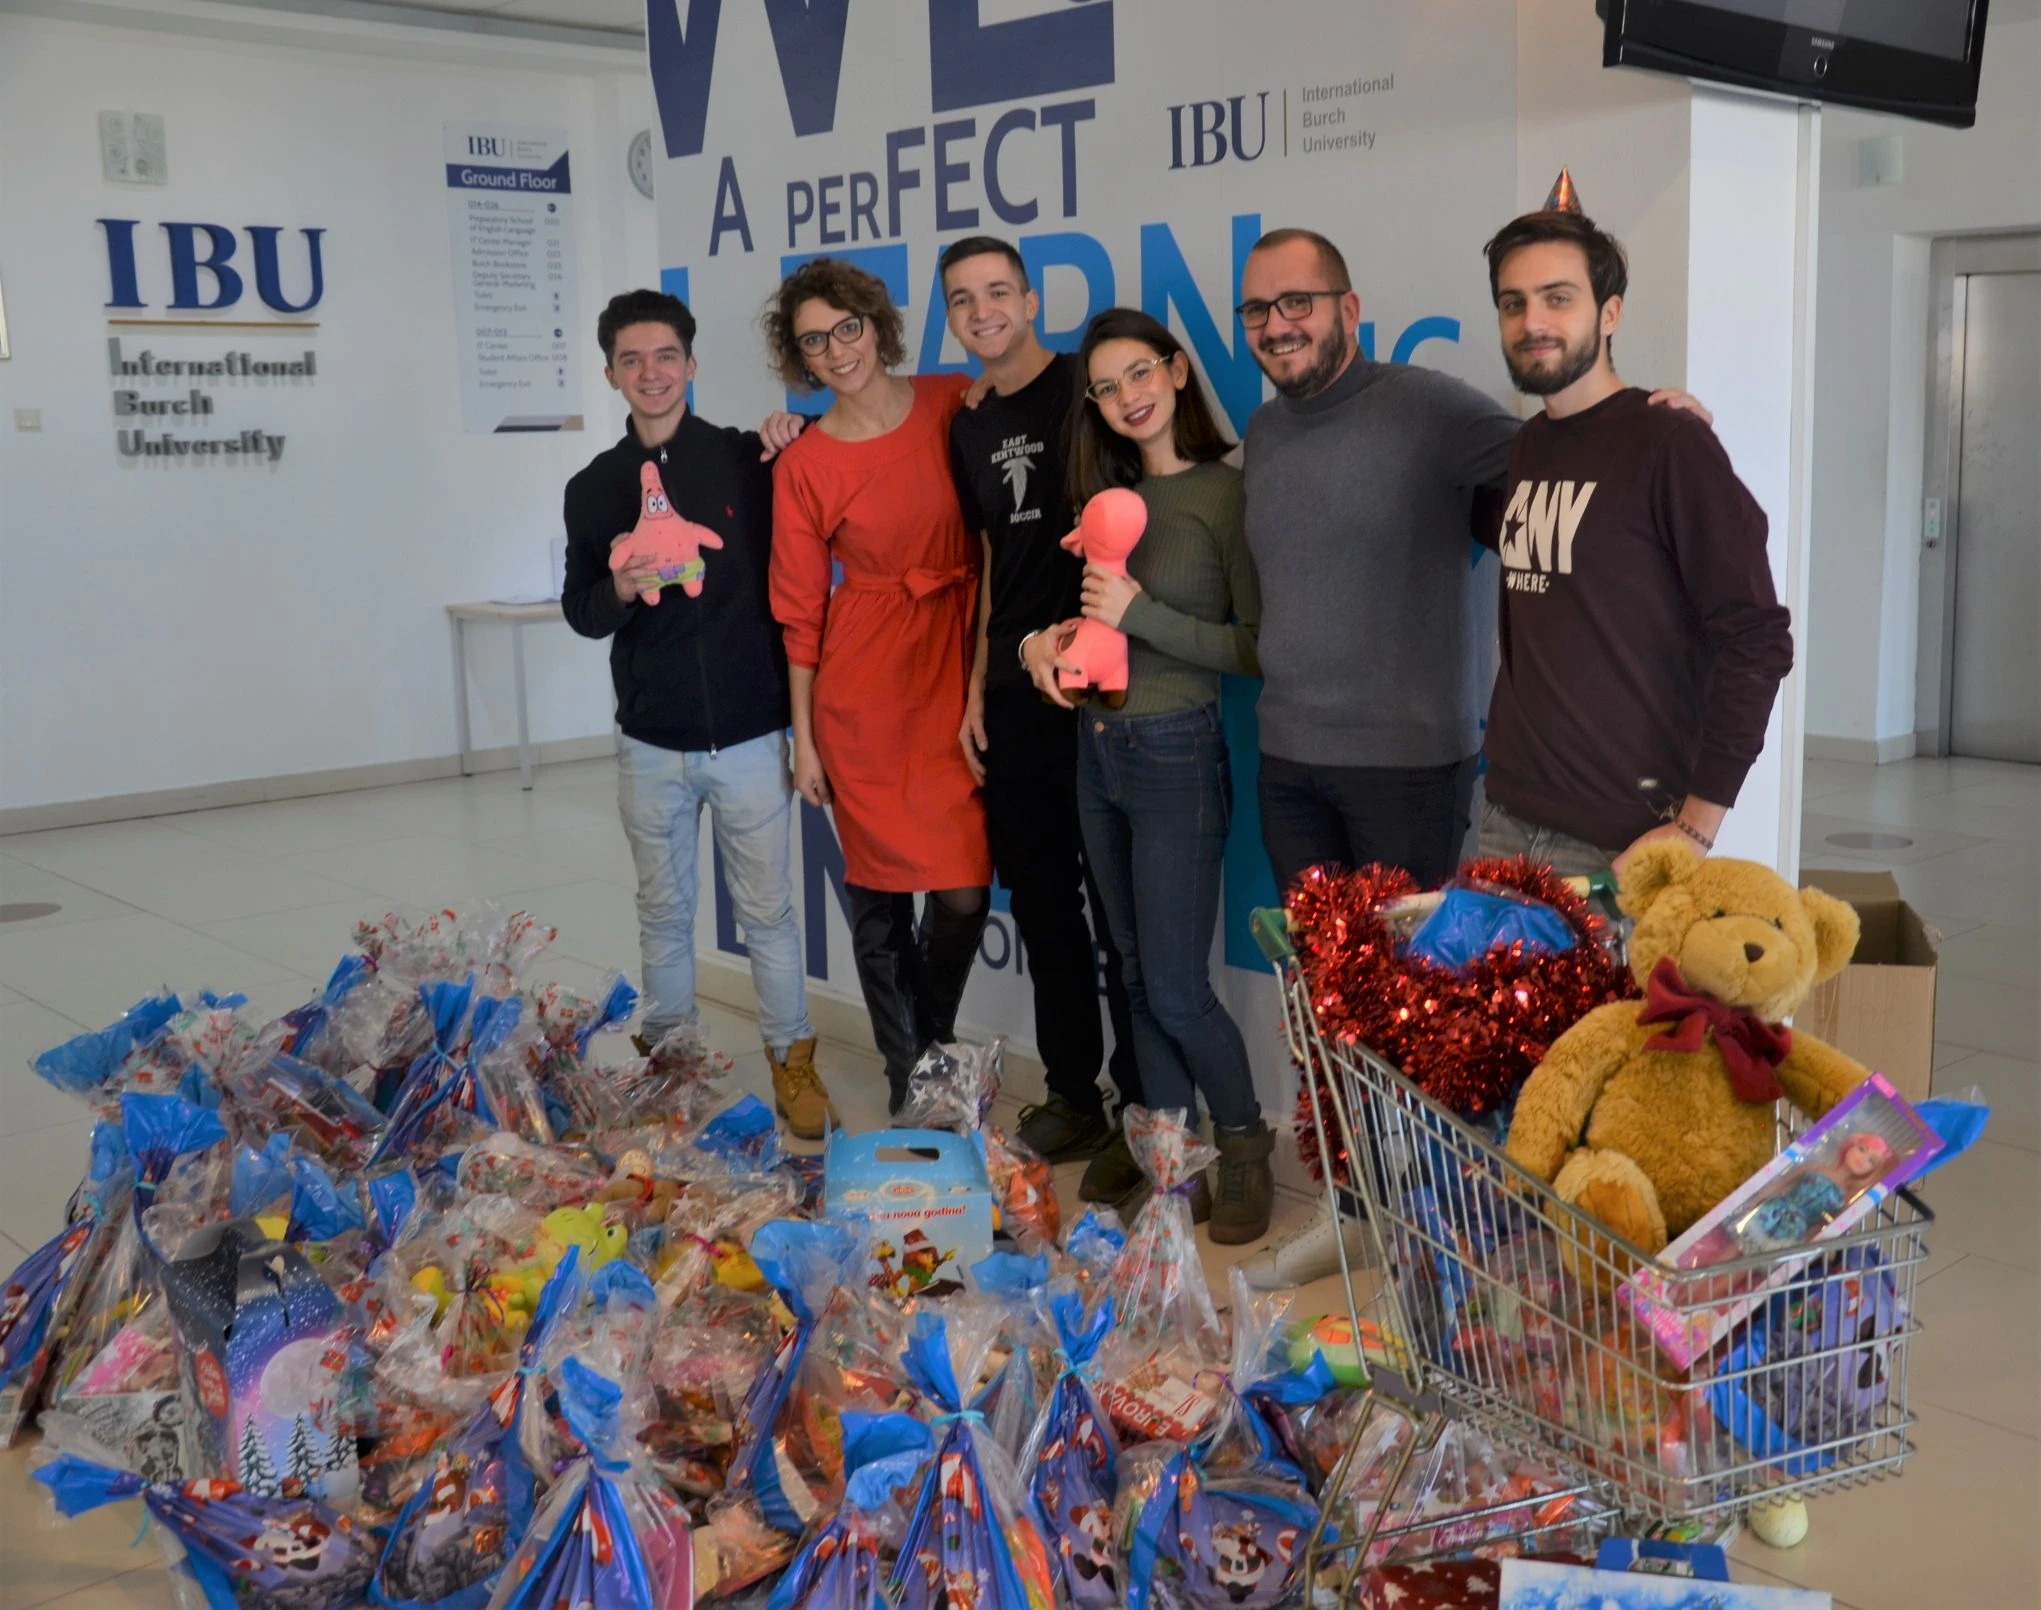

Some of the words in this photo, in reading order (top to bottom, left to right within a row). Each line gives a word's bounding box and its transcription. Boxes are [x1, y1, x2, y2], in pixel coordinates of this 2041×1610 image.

[1302, 72, 1394, 103] International
[1303, 107, 1345, 128] Burch
[1167, 91, 1270, 170] IBU
[1303, 129, 1376, 153] University
[467, 136, 505, 157] IBU
[461, 168, 517, 188] Ground
[519, 171, 558, 190] Floor
[708, 156, 754, 256] A
[787, 98, 1096, 248] PERFECT
[479, 225, 502, 234] English
[504, 226, 536, 236] Language
[509, 216, 534, 225] School
[502, 239, 532, 248] Manager
[508, 249, 529, 258] Office
[96, 218, 327, 313] IBU
[472, 259, 491, 268] Burch
[108, 336, 317, 377] International
[113, 388, 214, 416] Burch
[117, 429, 286, 462] University
[991, 441, 1045, 464] KENTWOOD
[1002, 433, 1028, 450] EAST
[924, 1204, 966, 1219] godina!
